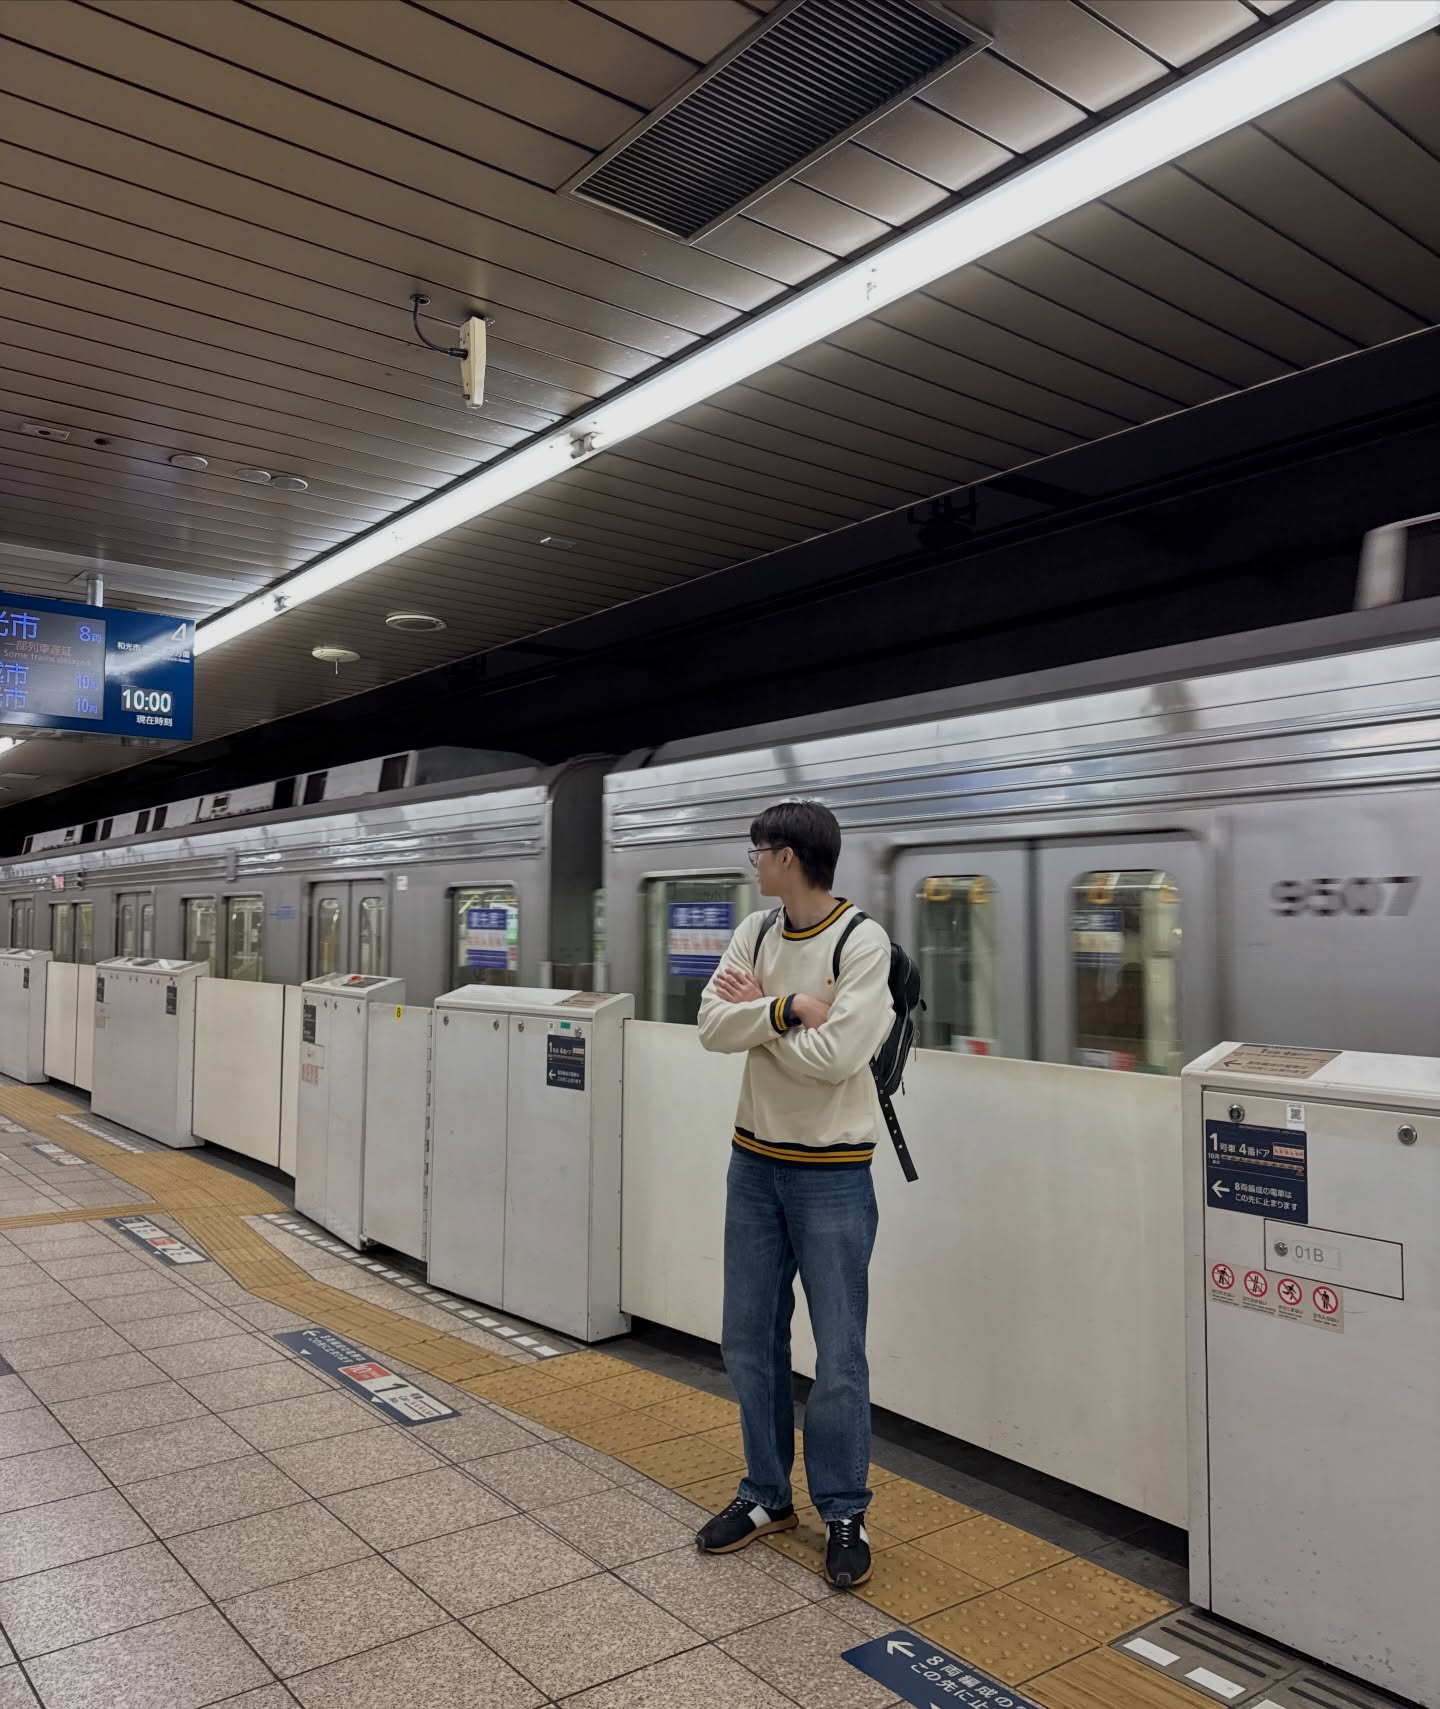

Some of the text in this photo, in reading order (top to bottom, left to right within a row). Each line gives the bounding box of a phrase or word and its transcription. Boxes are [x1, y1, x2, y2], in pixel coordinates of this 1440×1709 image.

[171, 623, 187, 641] 4
[3, 649, 29, 659] Some
[0, 662, 29, 686] 市
[0, 686, 29, 709] 市
[122, 688, 172, 713] 10:00
[135, 714, 173, 727] 現在時刻
[1209, 1132, 1236, 1153] 1号車
[1234, 1182, 1292, 1199] 8両編成の電車は
[1235, 1193, 1298, 1211] この先に止まります
[1295, 1245, 1324, 1263] 01B
[926, 1655, 1027, 1709] 8両編成の
